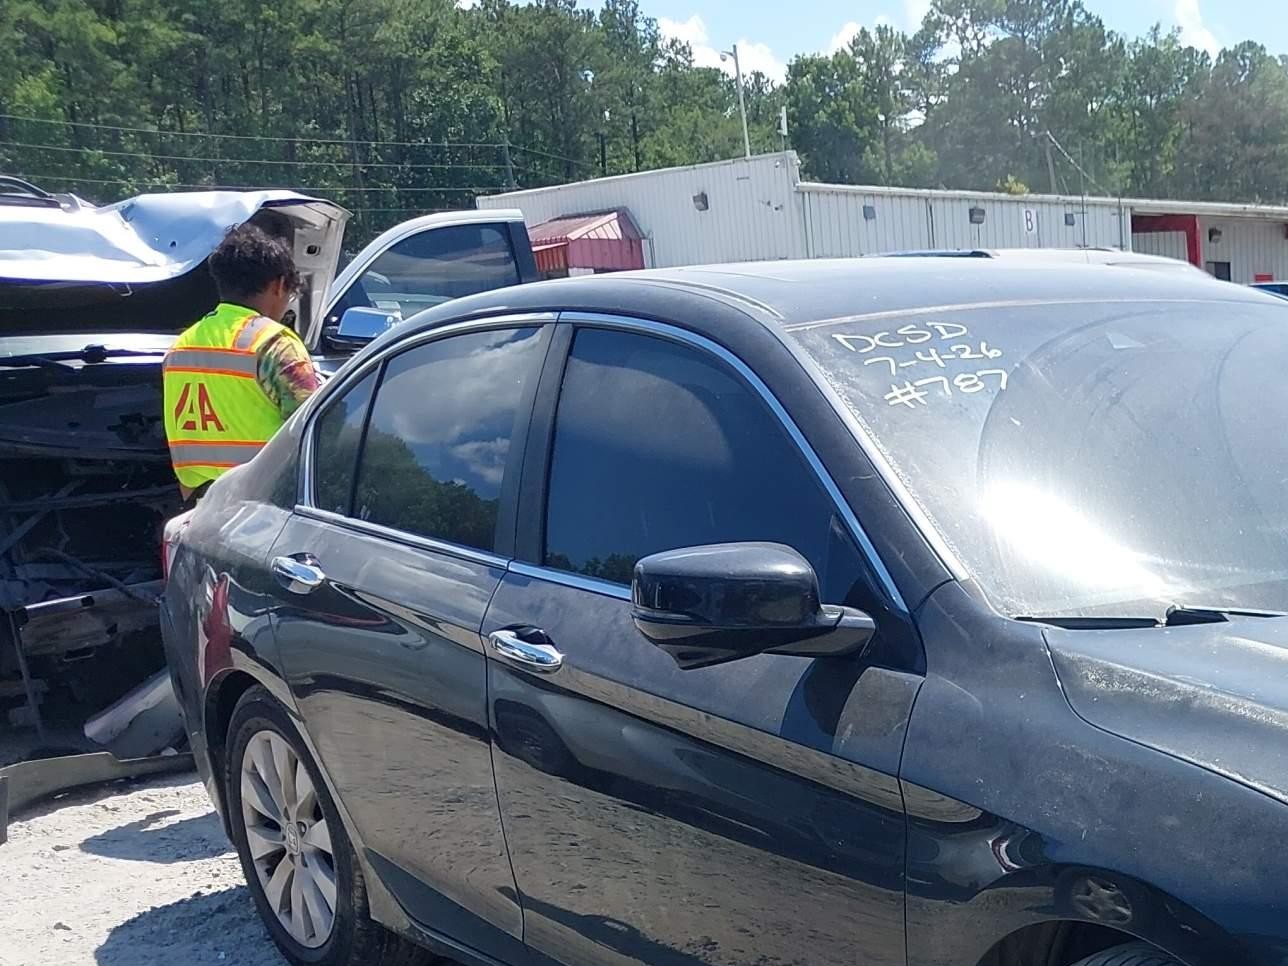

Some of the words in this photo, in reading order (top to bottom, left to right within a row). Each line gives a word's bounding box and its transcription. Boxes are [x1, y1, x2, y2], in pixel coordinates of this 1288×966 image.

[1024, 209, 1034, 232] B
[832, 321, 969, 353] DCSD
[863, 341, 1003, 376] 7-4-26
[884, 368, 1008, 409] #787
